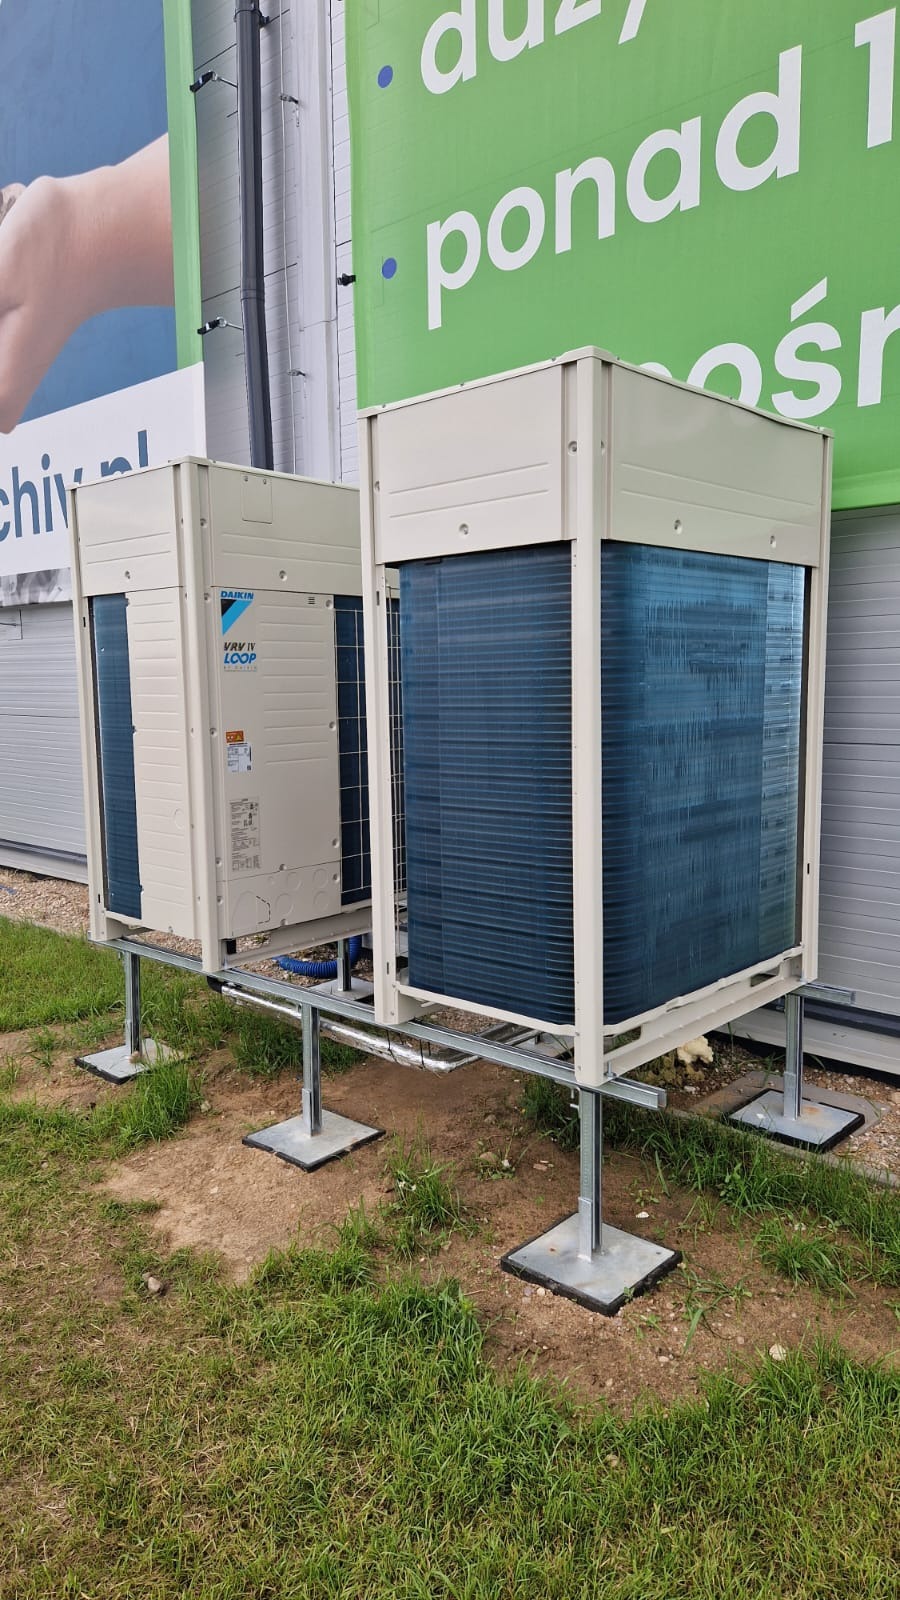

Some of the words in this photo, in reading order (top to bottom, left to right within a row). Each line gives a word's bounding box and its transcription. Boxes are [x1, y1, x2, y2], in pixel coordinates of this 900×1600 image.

[420, 0, 648, 94] du
[427, 44, 802, 330] ponad
[854, 7, 897, 149] 1
[220, 591, 254, 600] DAIKIN
[224, 642, 246, 651] VRV
[247, 642, 256, 651] IV
[224, 652, 257, 664] LOOP
